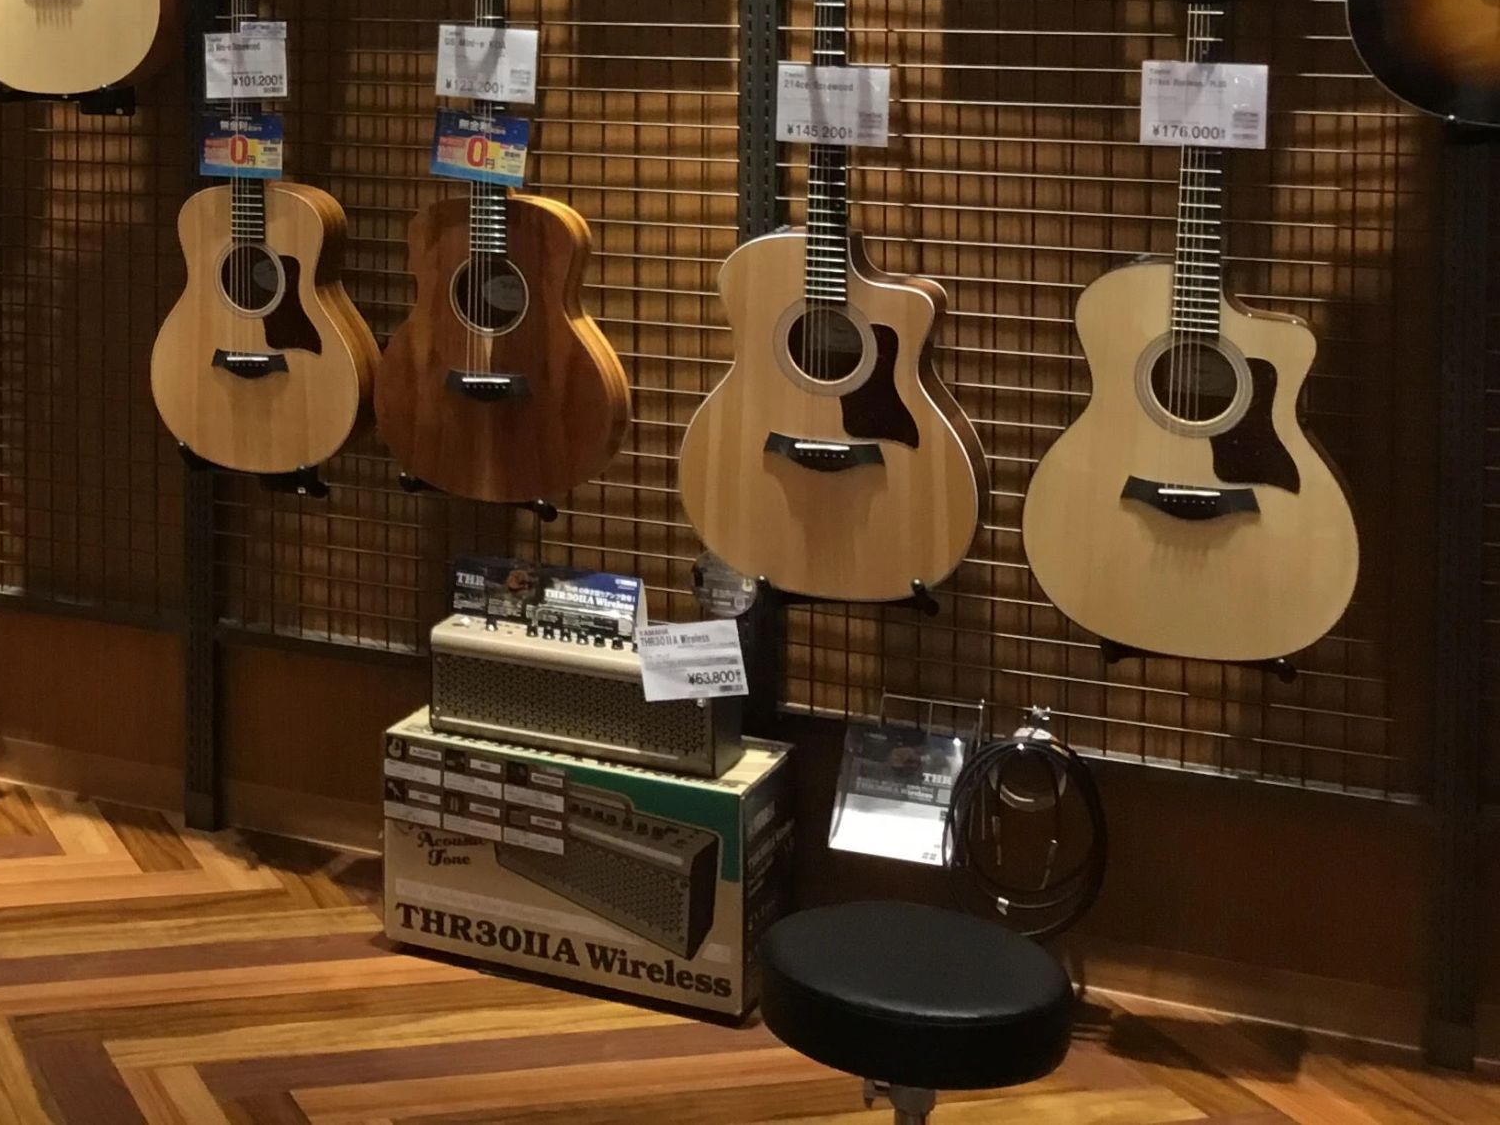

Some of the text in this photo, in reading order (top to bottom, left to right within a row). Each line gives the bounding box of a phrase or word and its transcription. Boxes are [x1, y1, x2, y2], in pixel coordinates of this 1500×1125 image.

[1153, 124, 1221, 140] ¥176,000
[456, 572, 485, 588] THR
[428, 848, 471, 867] Tone
[396, 901, 733, 998] THR30IIA Wireless
